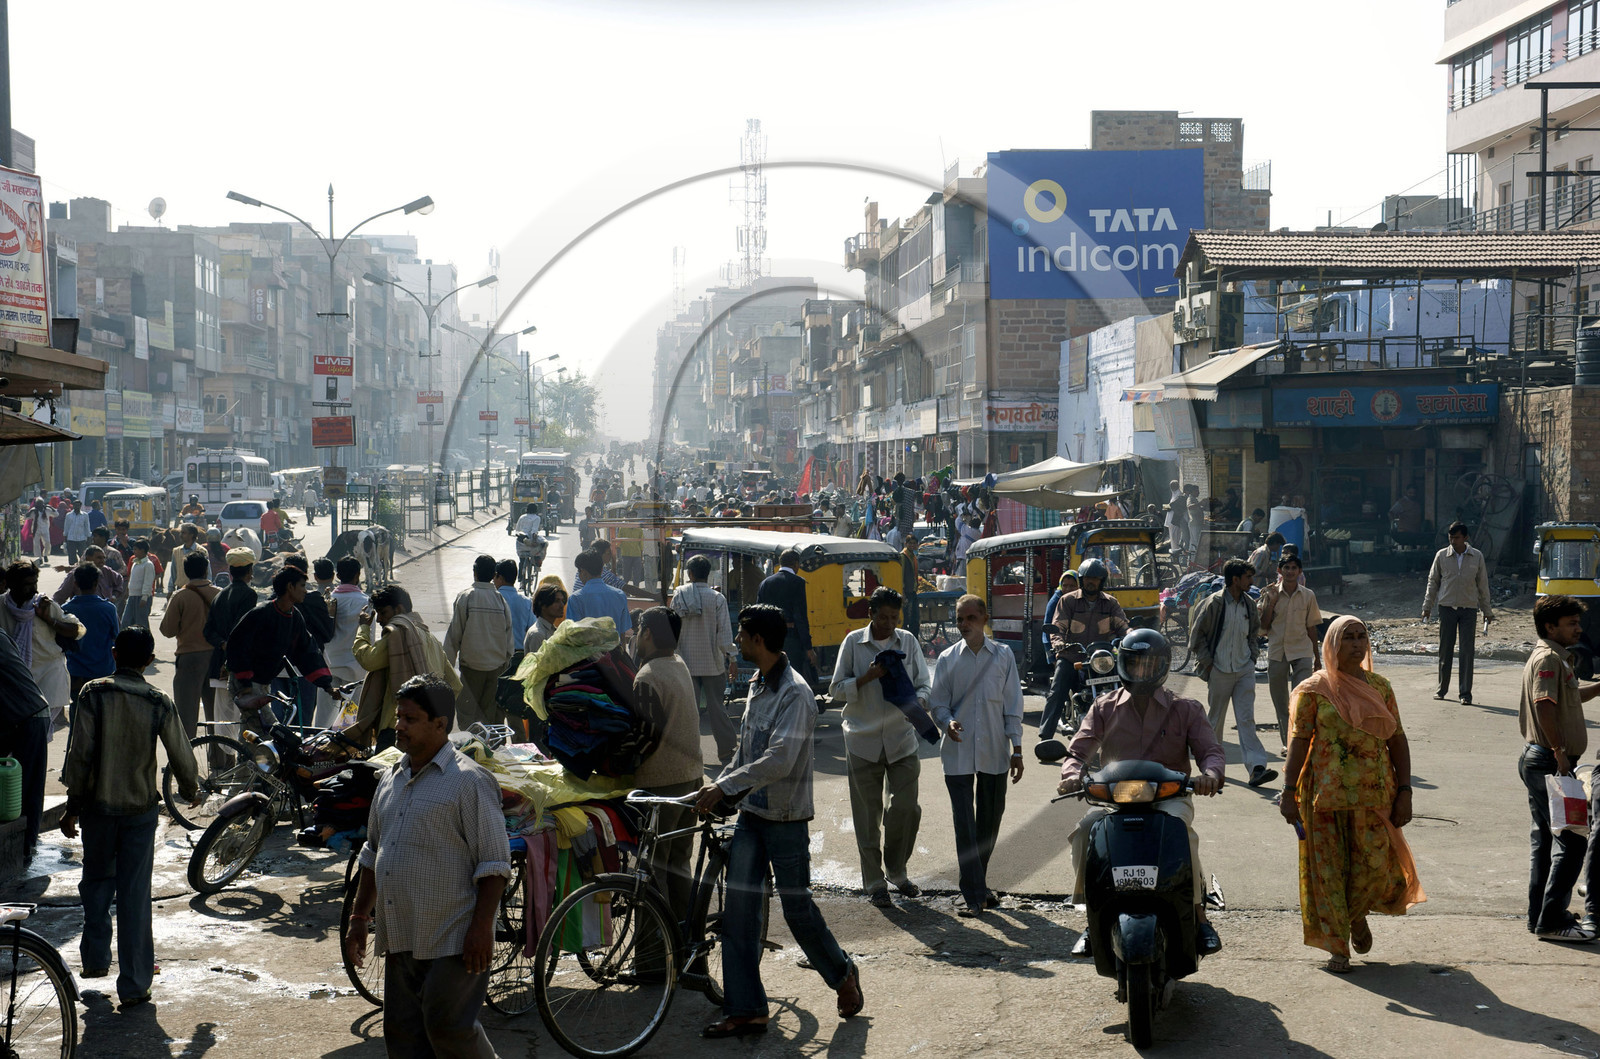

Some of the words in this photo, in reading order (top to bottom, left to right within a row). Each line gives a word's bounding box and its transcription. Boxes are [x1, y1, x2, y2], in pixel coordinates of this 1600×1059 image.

[1089, 207, 1178, 233] TATA
[1017, 231, 1180, 273] indicom
[31, 282, 43, 293] तक
[255, 288, 264, 321] cello
[327, 365, 351, 375] Lifestyle
[985, 402, 1043, 424] भगवती
[1306, 389, 1356, 419] शाही
[1415, 386, 1488, 414] समोसा
[1123, 868, 1135, 877] RJ
[1136, 868, 1146, 877] 19
